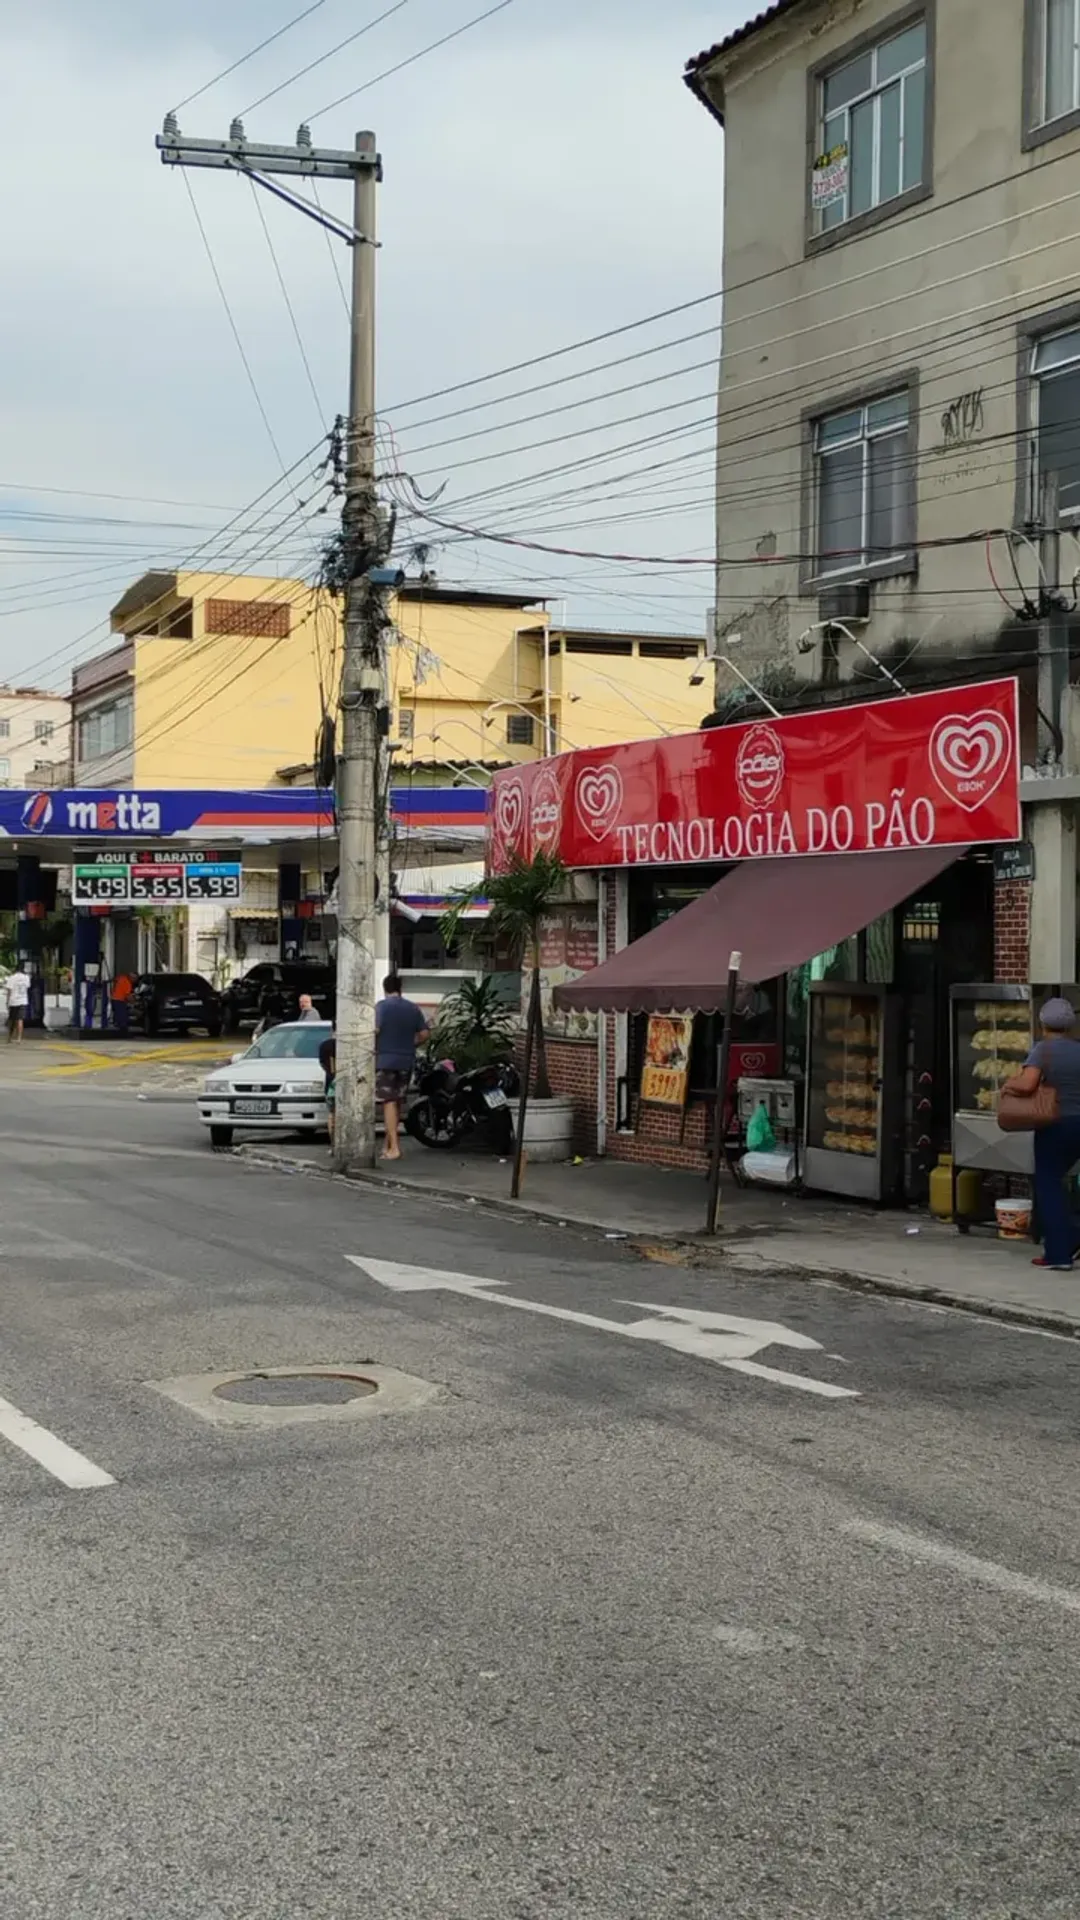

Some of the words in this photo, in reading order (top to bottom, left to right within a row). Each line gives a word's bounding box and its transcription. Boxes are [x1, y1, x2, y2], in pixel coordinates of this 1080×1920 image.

[66, 794, 160, 830] metta
[617, 811, 798, 864] TECNOLOGIA
[806, 804, 853, 852] DO
[865, 788, 935, 849] PÃO
[96, 853, 126, 864] AQUI
